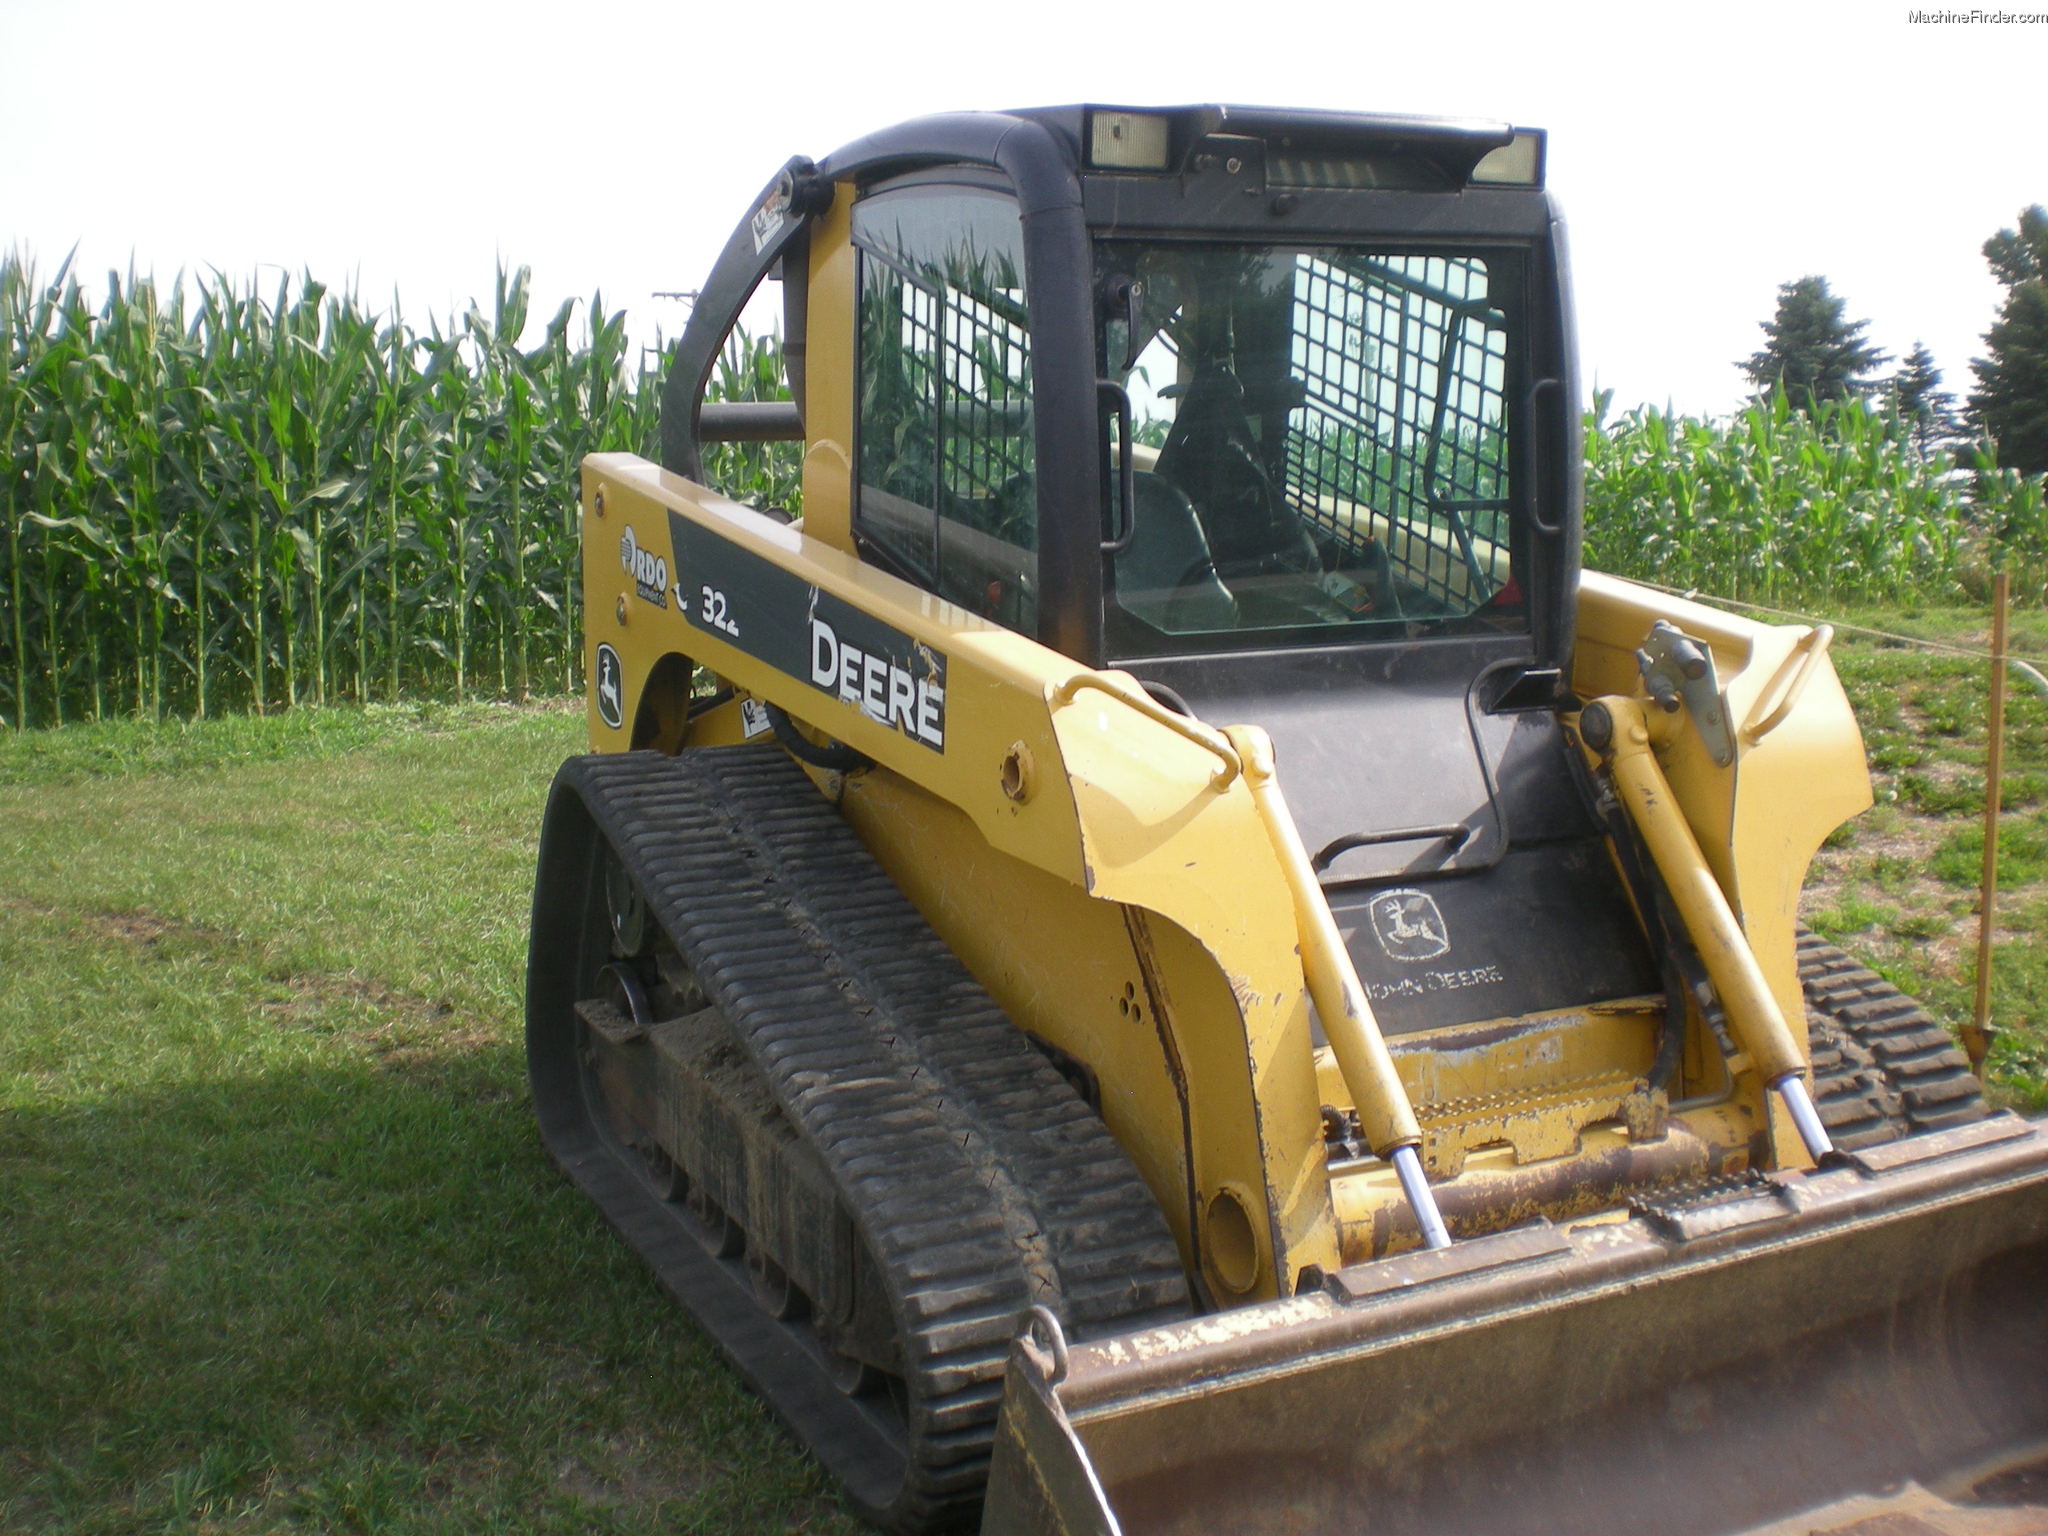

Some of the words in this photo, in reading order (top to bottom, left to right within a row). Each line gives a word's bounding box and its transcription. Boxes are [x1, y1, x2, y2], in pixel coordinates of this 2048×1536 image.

[636, 547, 667, 593] RDO
[811, 618, 944, 747] DEERE
[1424, 965, 1504, 991] DEERE
